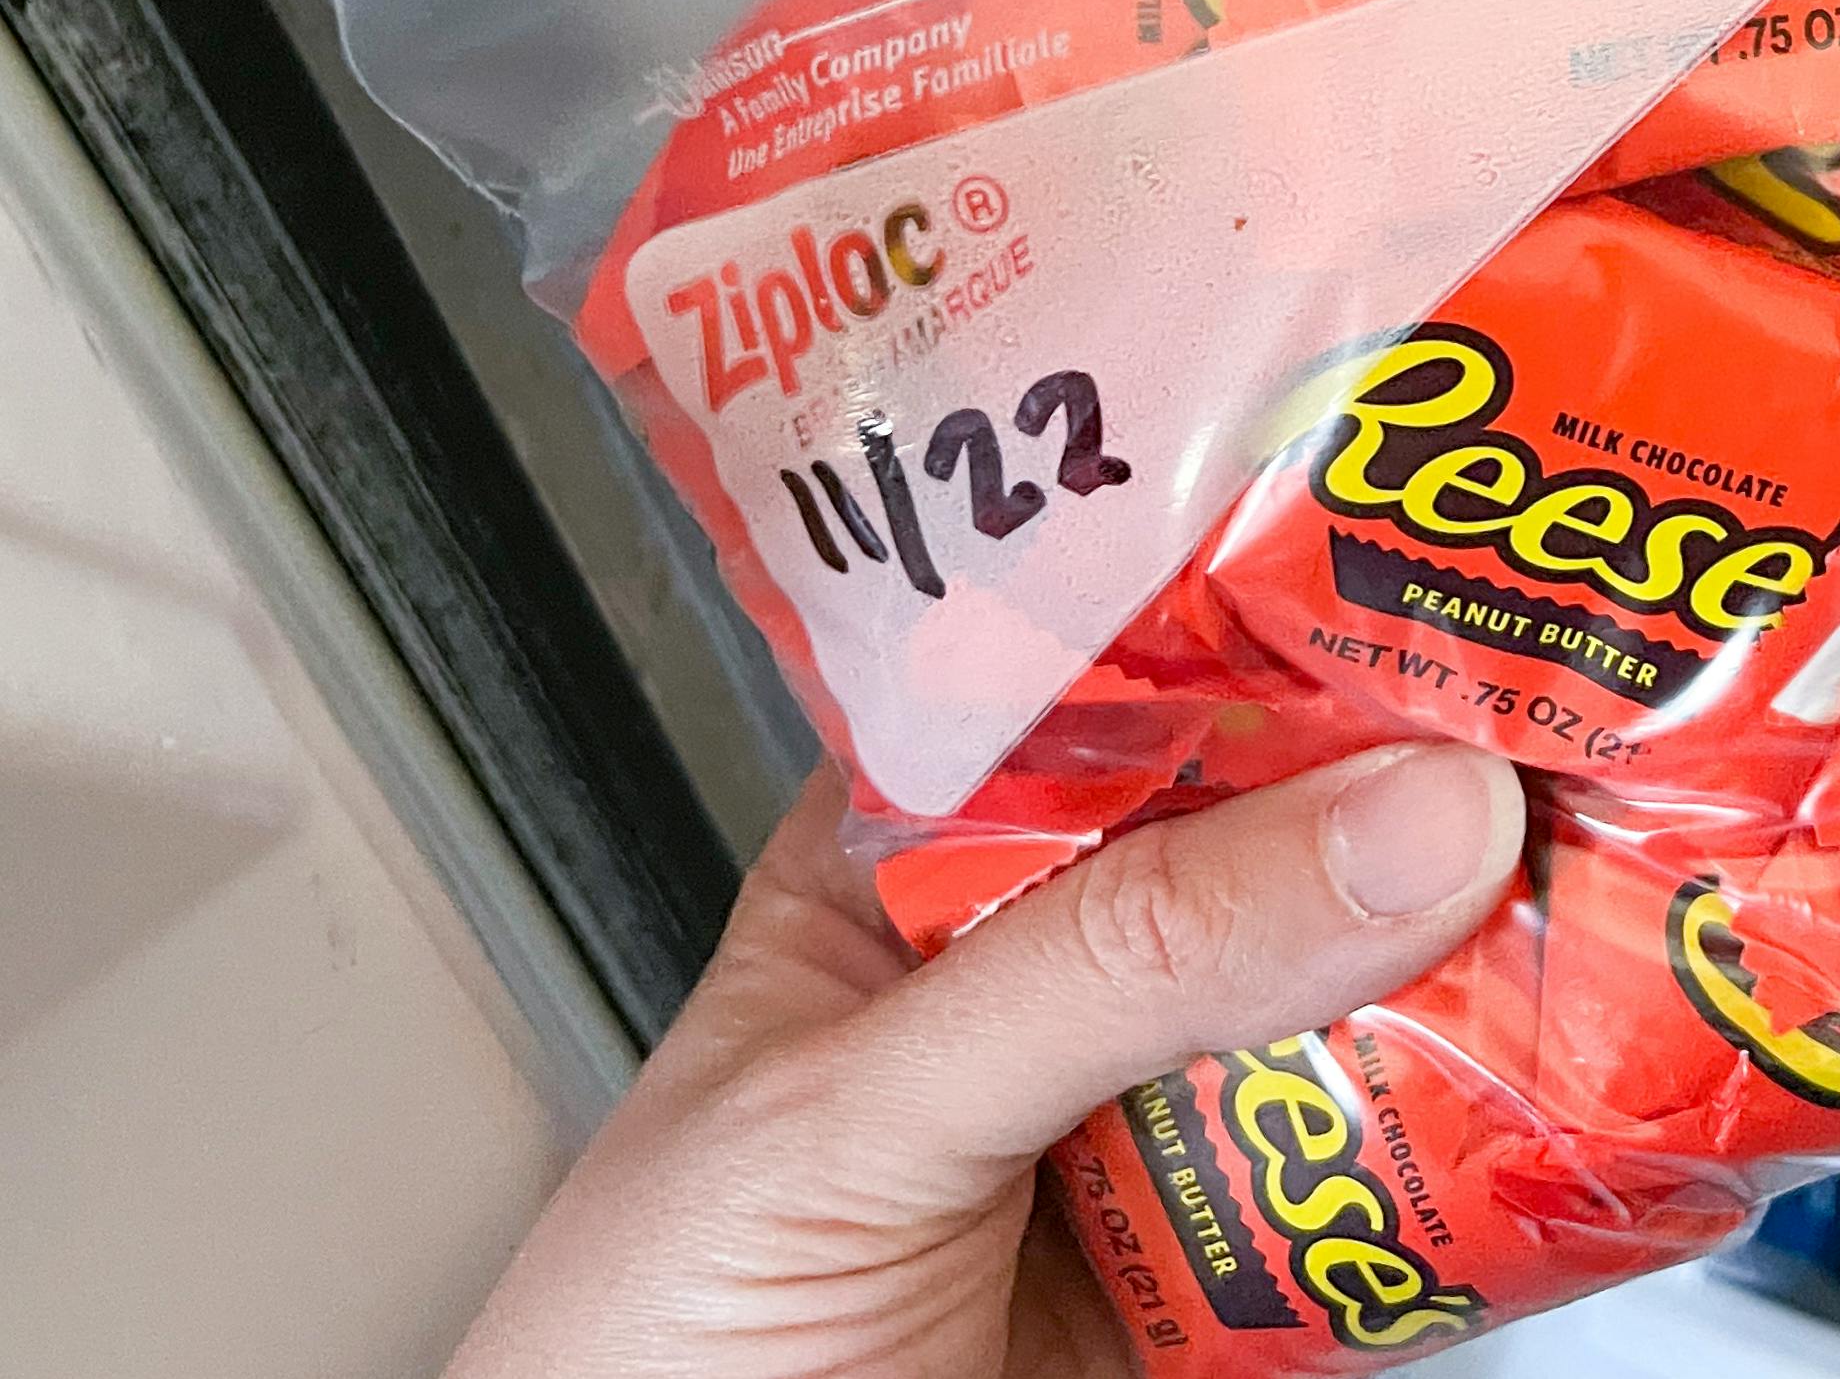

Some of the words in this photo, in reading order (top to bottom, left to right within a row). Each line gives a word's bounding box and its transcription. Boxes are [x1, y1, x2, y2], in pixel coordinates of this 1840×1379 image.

[718, 105, 741, 135] A
[736, 69, 812, 126] Family
[811, 12, 974, 85] Company
[1738, 14, 1793, 61] .75
[727, 139, 768, 182] Une
[773, 79, 902, 157] Entreprise
[912, 27, 1073, 101] Familiale
[664, 200, 947, 414] Ziploc
[1250, 334, 1818, 633] Reese
[1552, 411, 1624, 456] MILK
[1631, 439, 1790, 509] CHOCOLATE
[1308, 626, 1393, 668] NET
[1397, 650, 1459, 691] WT
[1460, 680, 1521, 716] .75
[1526, 695, 1584, 742] OZ
[1402, 582, 1533, 638] PEANUT
[1538, 622, 1660, 689] BUTTER
[1233, 1044, 1471, 1348] ese's
[1353, 1032, 1393, 1103] MILK
[1377, 1106, 1454, 1248] CHOCOLATE
[1101, 1208, 1143, 1257] OZ
[1167, 1167, 1239, 1278] BUTTER
